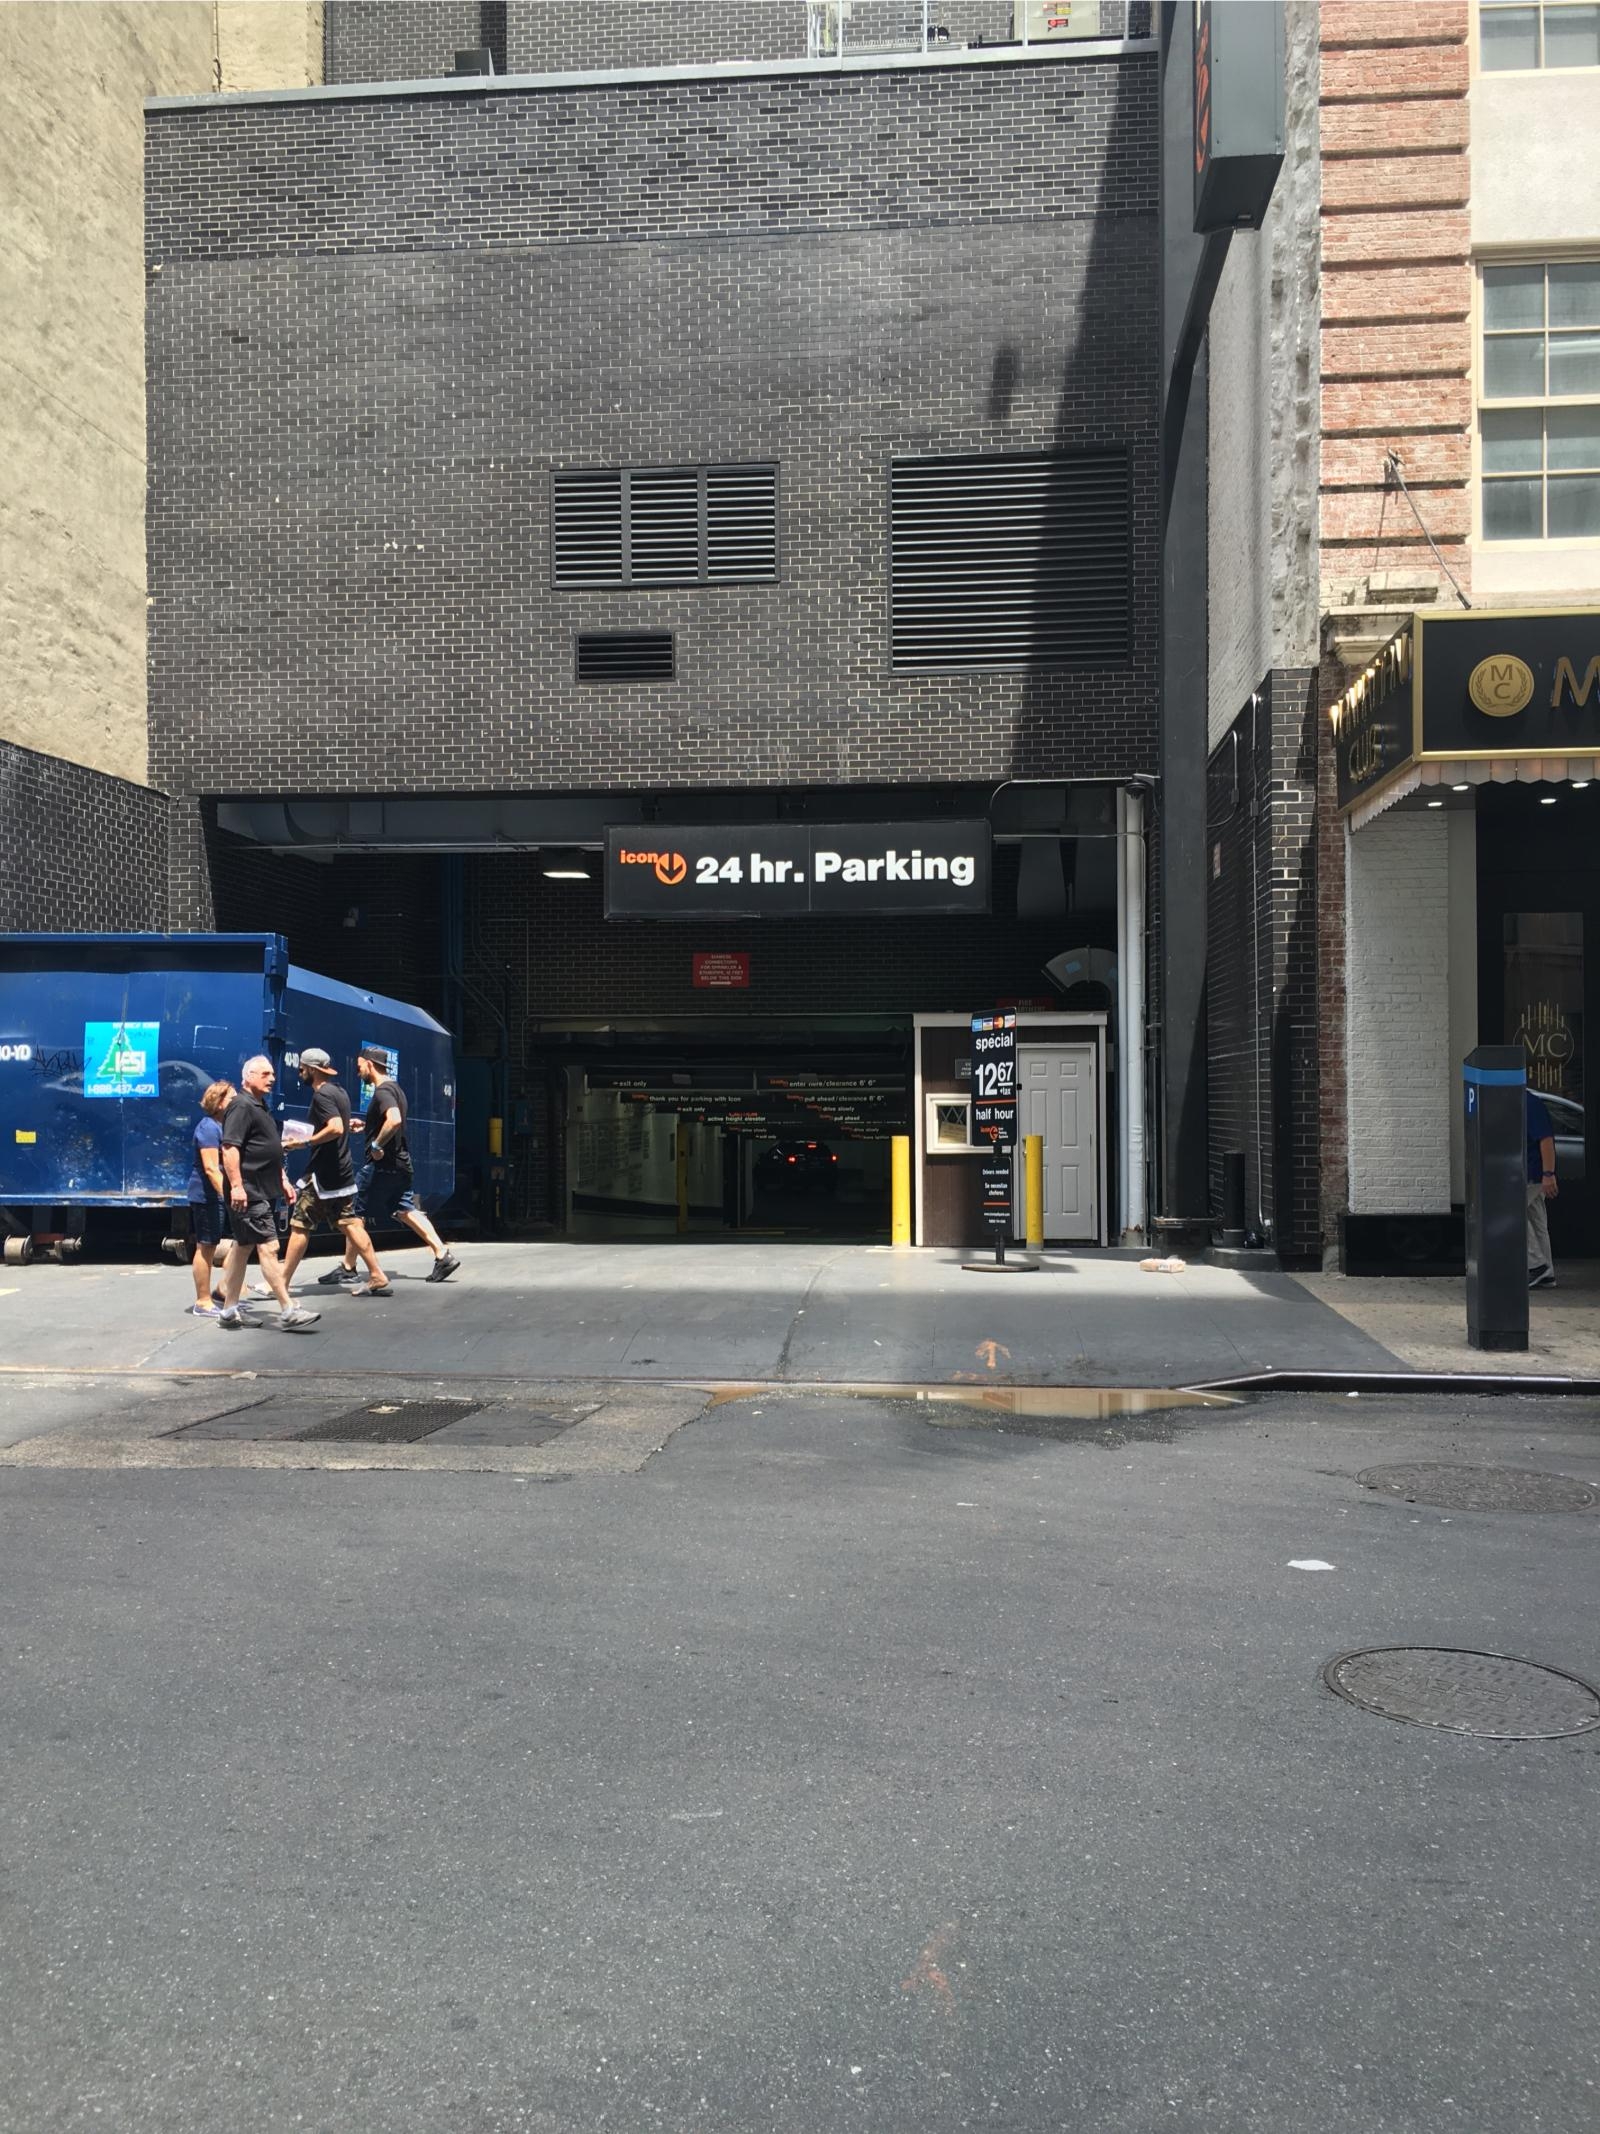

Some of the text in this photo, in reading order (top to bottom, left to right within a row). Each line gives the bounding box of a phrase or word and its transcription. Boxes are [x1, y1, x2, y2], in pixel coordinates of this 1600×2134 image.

[620, 850, 658, 864] icon
[696, 850, 975, 887] 24 hr. Parking
[975, 1032, 1014, 1052] special
[633, 1080, 647, 1088] only
[1468, 1087, 1475, 1113] P
[975, 1107, 1014, 1120] half hour
